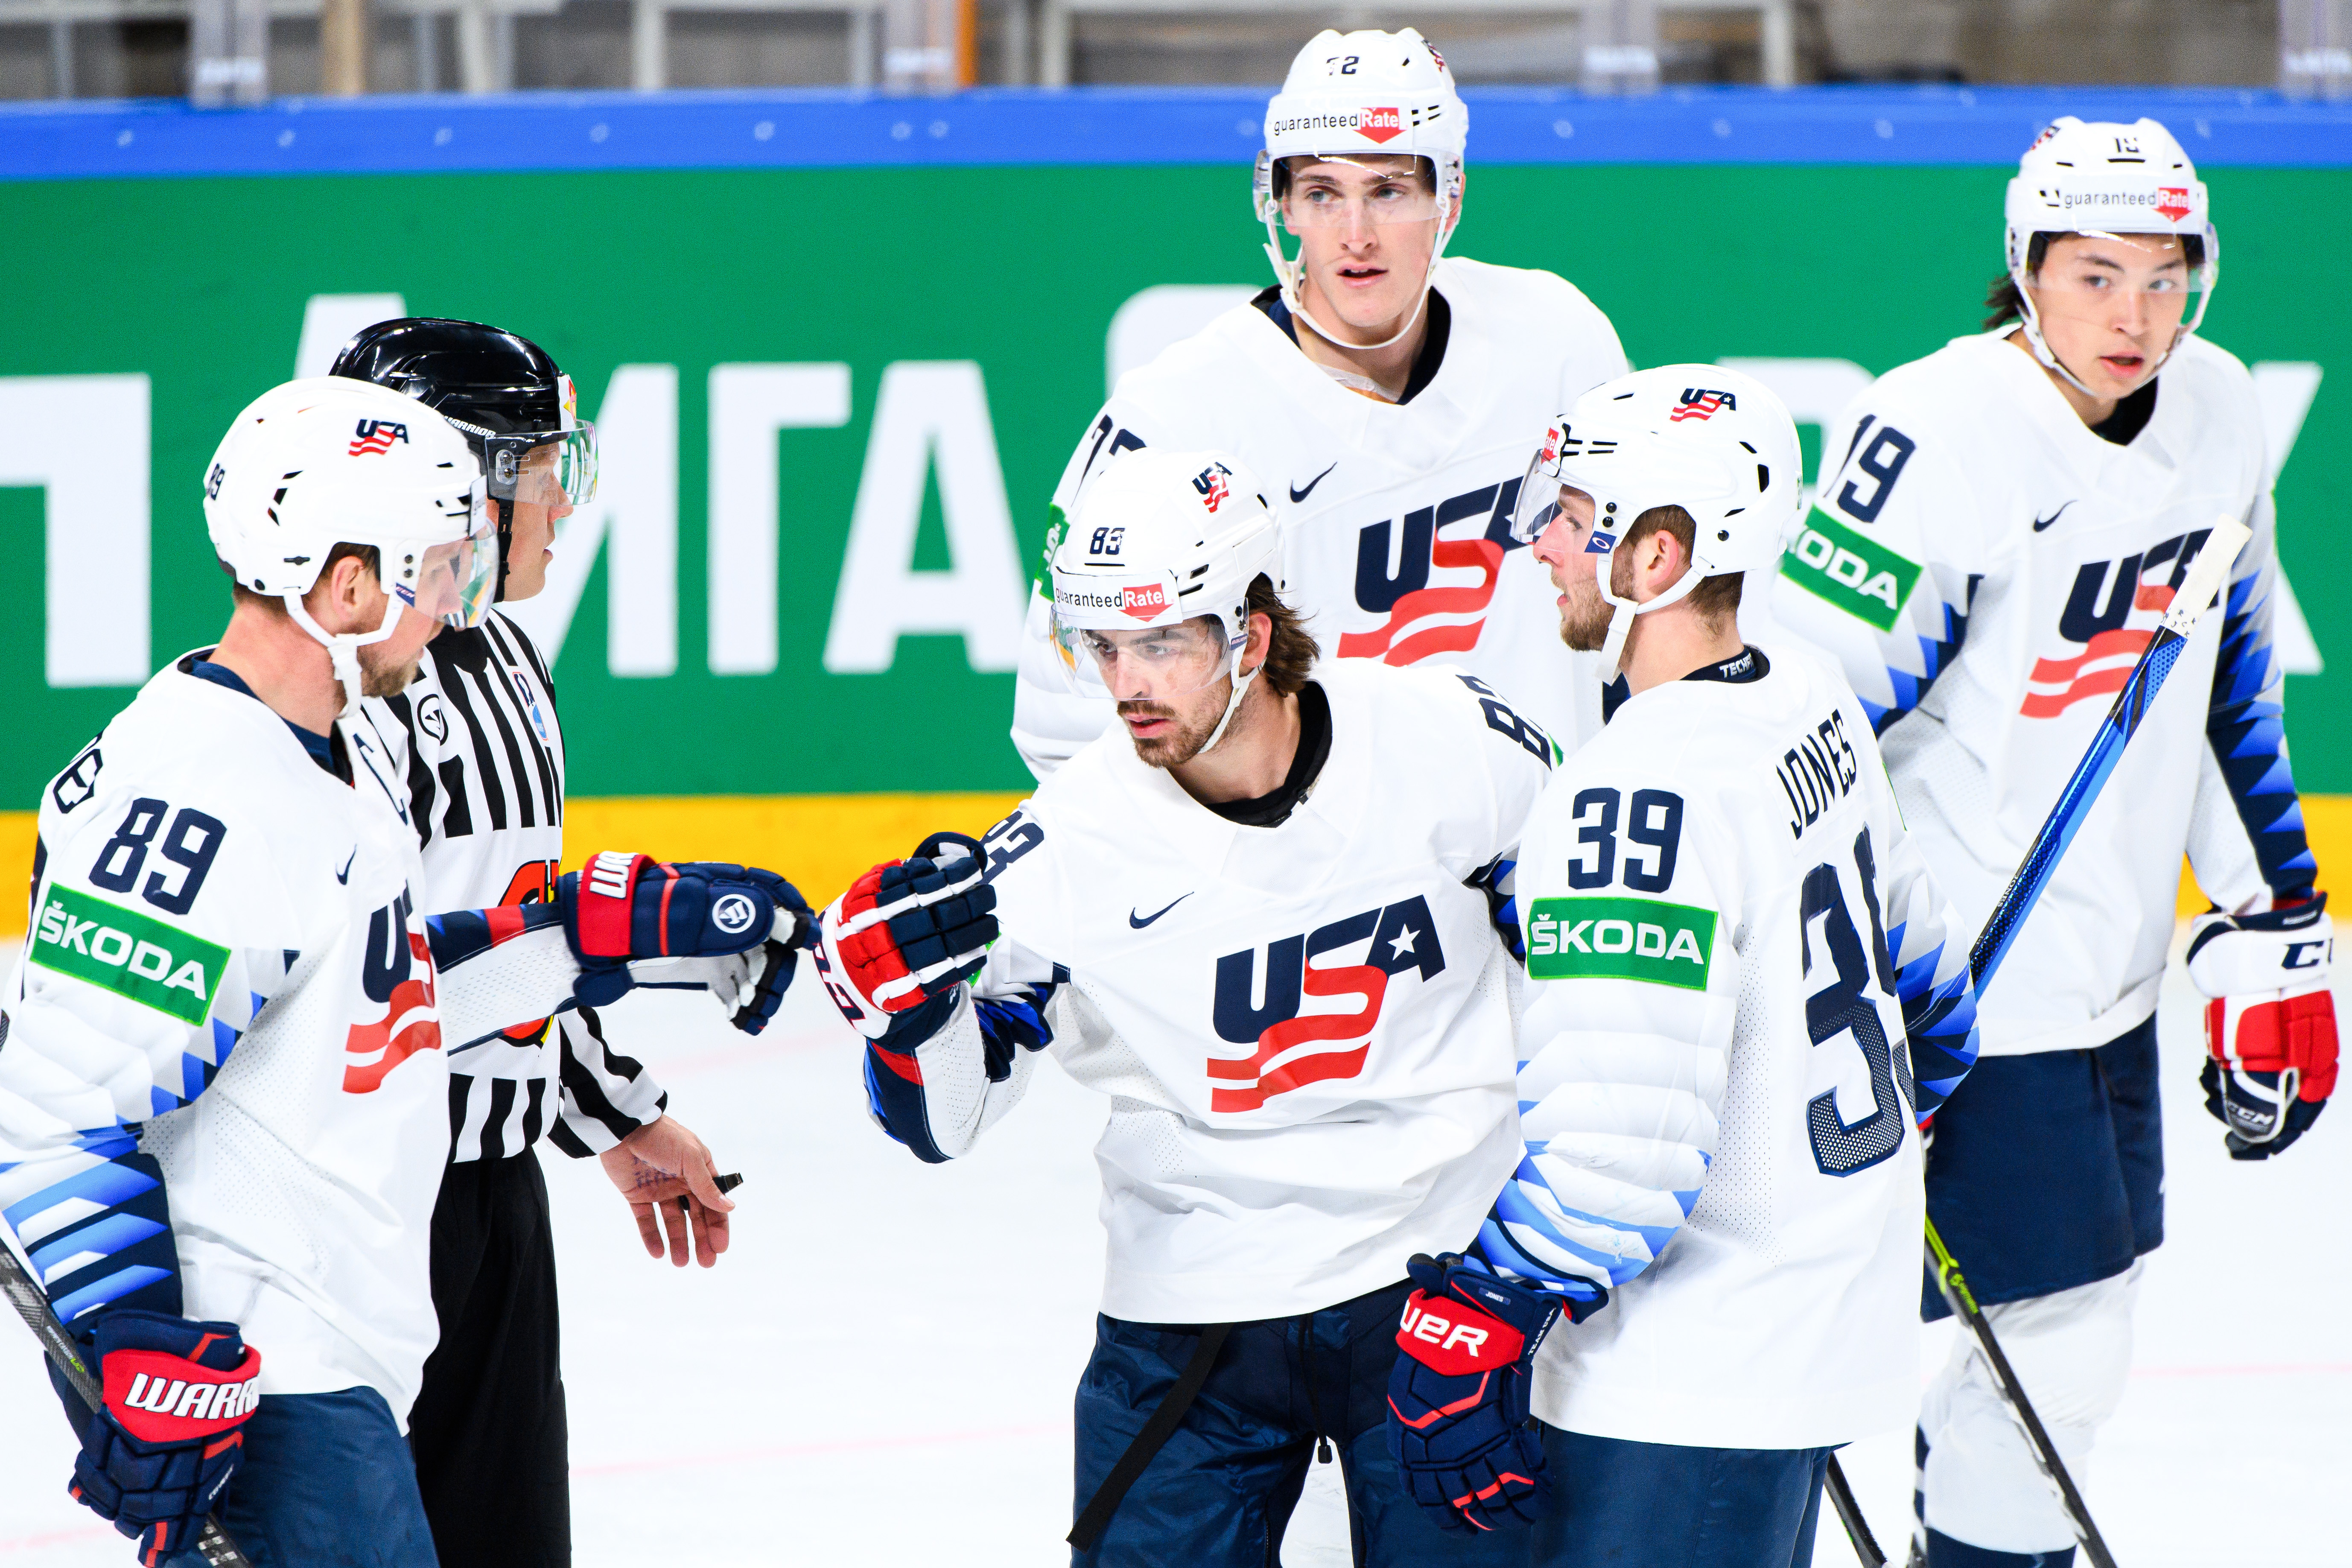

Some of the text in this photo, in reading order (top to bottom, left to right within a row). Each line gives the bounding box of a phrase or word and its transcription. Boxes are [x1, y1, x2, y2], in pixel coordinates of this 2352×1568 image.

[1361, 109, 1399, 128] Rate
[1674, 388, 1736, 417] USA
[352, 419, 409, 452] USA
[1191, 461, 1232, 507] USA
[1824, 414, 1917, 524] 19
[1089, 527, 1126, 555] 83
[1055, 586, 1164, 608] guaranteed Rate
[1775, 709, 1857, 840] JONES
[88, 797, 227, 915] 89
[1568, 787, 1684, 893] 39
[38, 901, 207, 1001] ŠKODA
[1531, 914, 1704, 965] ŠKODA
[1208, 894, 1446, 1093] USA
[1528, 1329, 1545, 1355] TEAM
